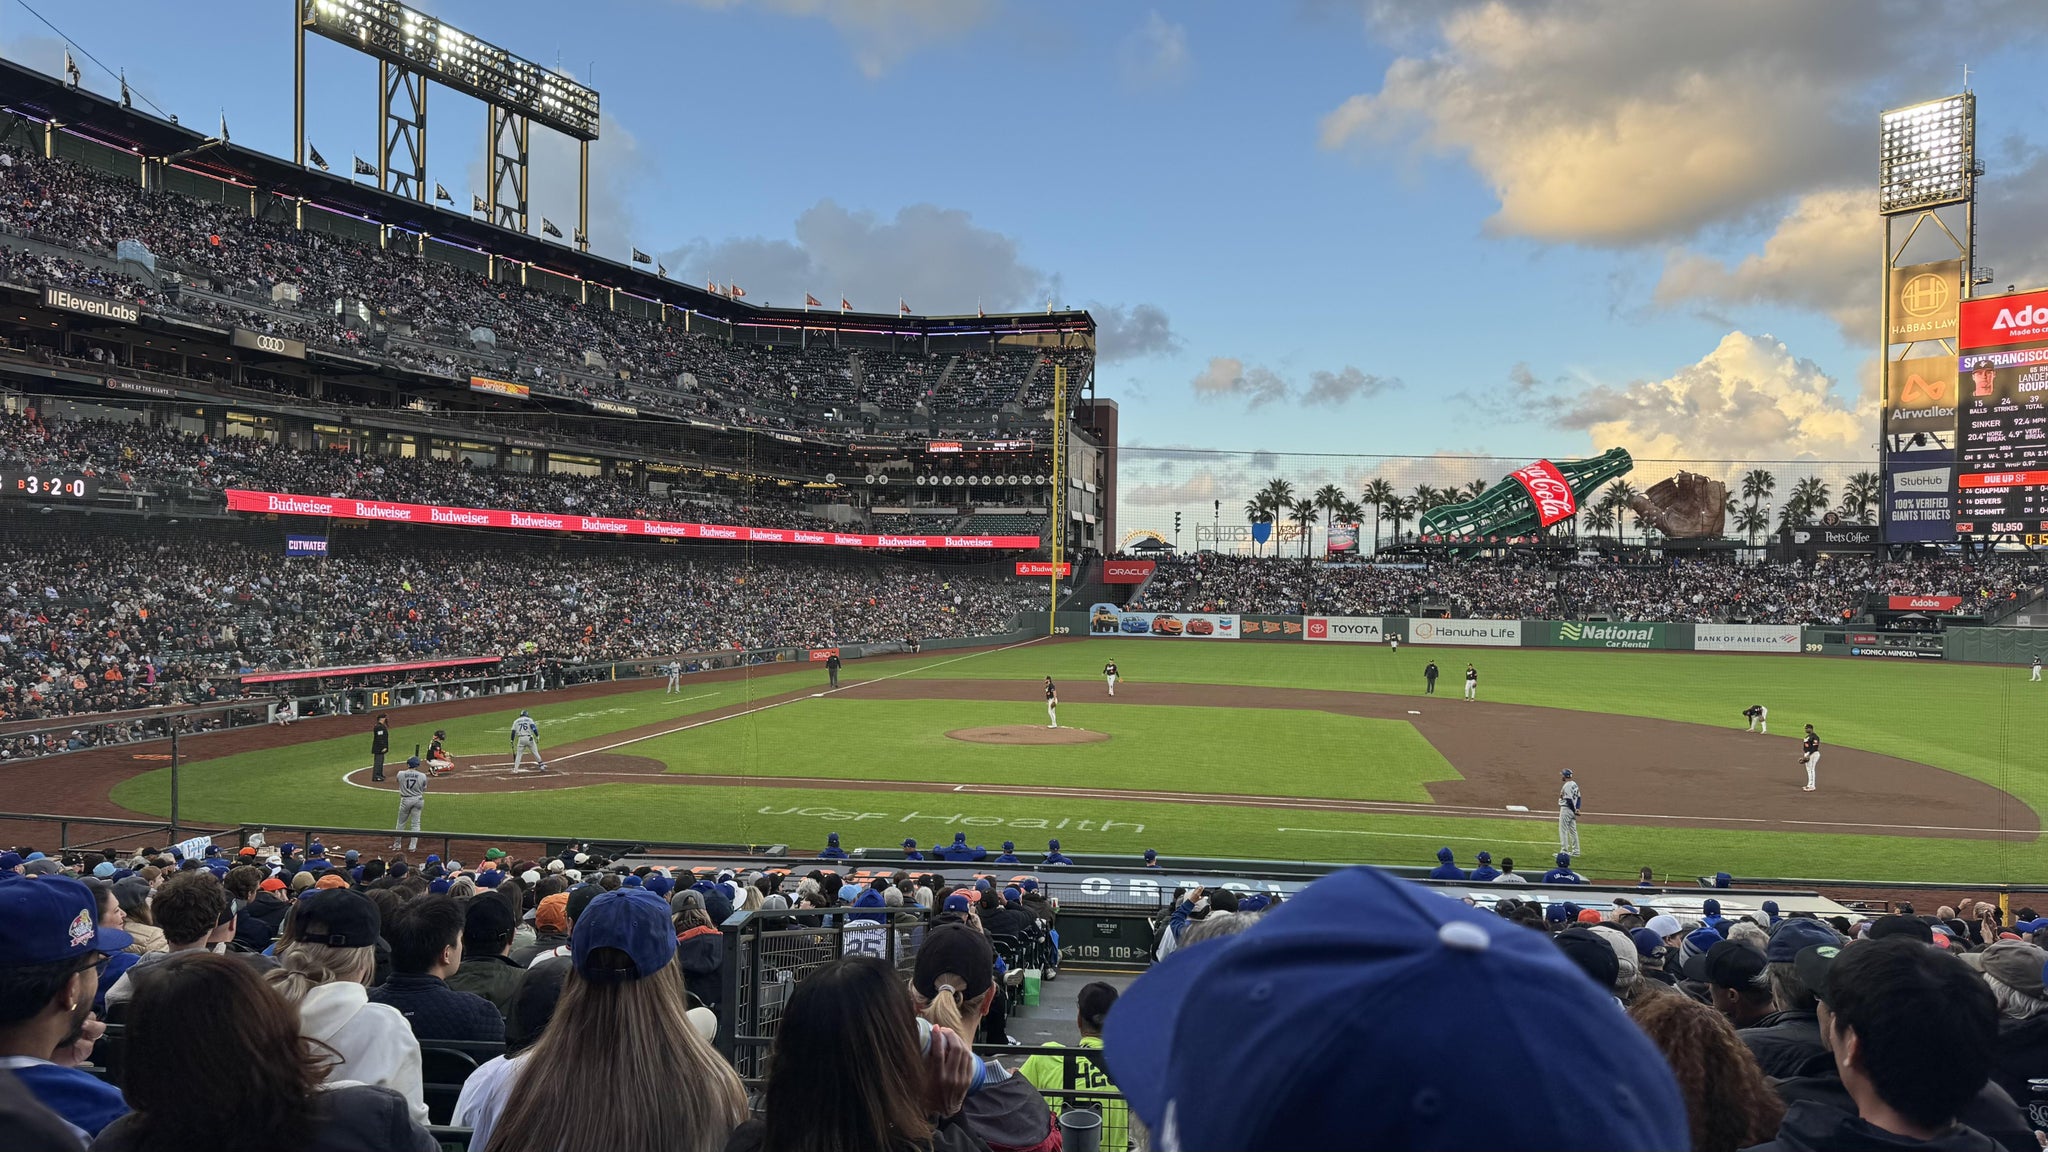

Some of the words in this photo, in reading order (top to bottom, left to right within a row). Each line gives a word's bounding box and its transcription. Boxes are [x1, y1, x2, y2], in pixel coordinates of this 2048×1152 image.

[1892, 320, 1933, 335] HABBAS
[1935, 318, 1957, 329] LAW
[2009, 329, 2031, 337] Made
[1892, 406, 1955, 420] Airwallex
[1971, 420, 2001, 428] SINKER
[1900, 475, 1943, 487] StubHub
[1984, 475, 2001, 484] DUE
[2002, 474, 2014, 483] UP
[2016, 473, 2027, 482] SF
[17, 479, 25, 489] B
[26, 475, 38, 494] 3
[42, 481, 50, 491] S
[50, 477, 62, 496] 2
[268, 496, 332, 514] Budweiser
[1895, 499, 1914, 510] 100%
[1916, 497, 1948, 509] VERIFIED
[355, 502, 411, 519] Budweiser
[1892, 510, 1918, 521] GIANTS
[1918, 509, 1950, 520] TICKETS
[431, 508, 489, 525] Budweiser
[510, 514, 562, 528] Budweiser
[582, 518, 628, 532] Budweiser
[644, 522, 684, 535] Budweiser
[1992, 522, 2023, 533] $11,950
[700, 526, 736, 538] Budweiser
[750, 530, 782, 541] Budweiser
[834, 534, 862, 545] Budweiser
[878, 536, 926, 546] Budweiser
[945, 537, 992, 547] Budweiser
[1846, 532, 1870, 544] Coffee
[288, 540, 327, 551] CUTWATER
[1108, 568, 1150, 576] ORACLE
[1910, 599, 1940, 607] Adobe
[1054, 626, 1070, 634] 339
[1331, 624, 1379, 635] TOYOTA
[1436, 626, 1488, 638] Hanwha
[1490, 627, 1515, 638] Life
[1581, 625, 1654, 640] National
[1606, 640, 1621, 648] Car
[1621, 641, 1650, 649] Rental
[1805, 643, 1823, 652] 399
[1860, 648, 1887, 656] KONICA
[1887, 649, 1917, 657] MINOLTA
[519, 722, 528, 731] 76
[406, 779, 416, 790] 17
[757, 805, 888, 822] UCSF
[900, 811, 1145, 834] Health
[1078, 945, 1100, 958] 109
[1109, 946, 1131, 959] 108
